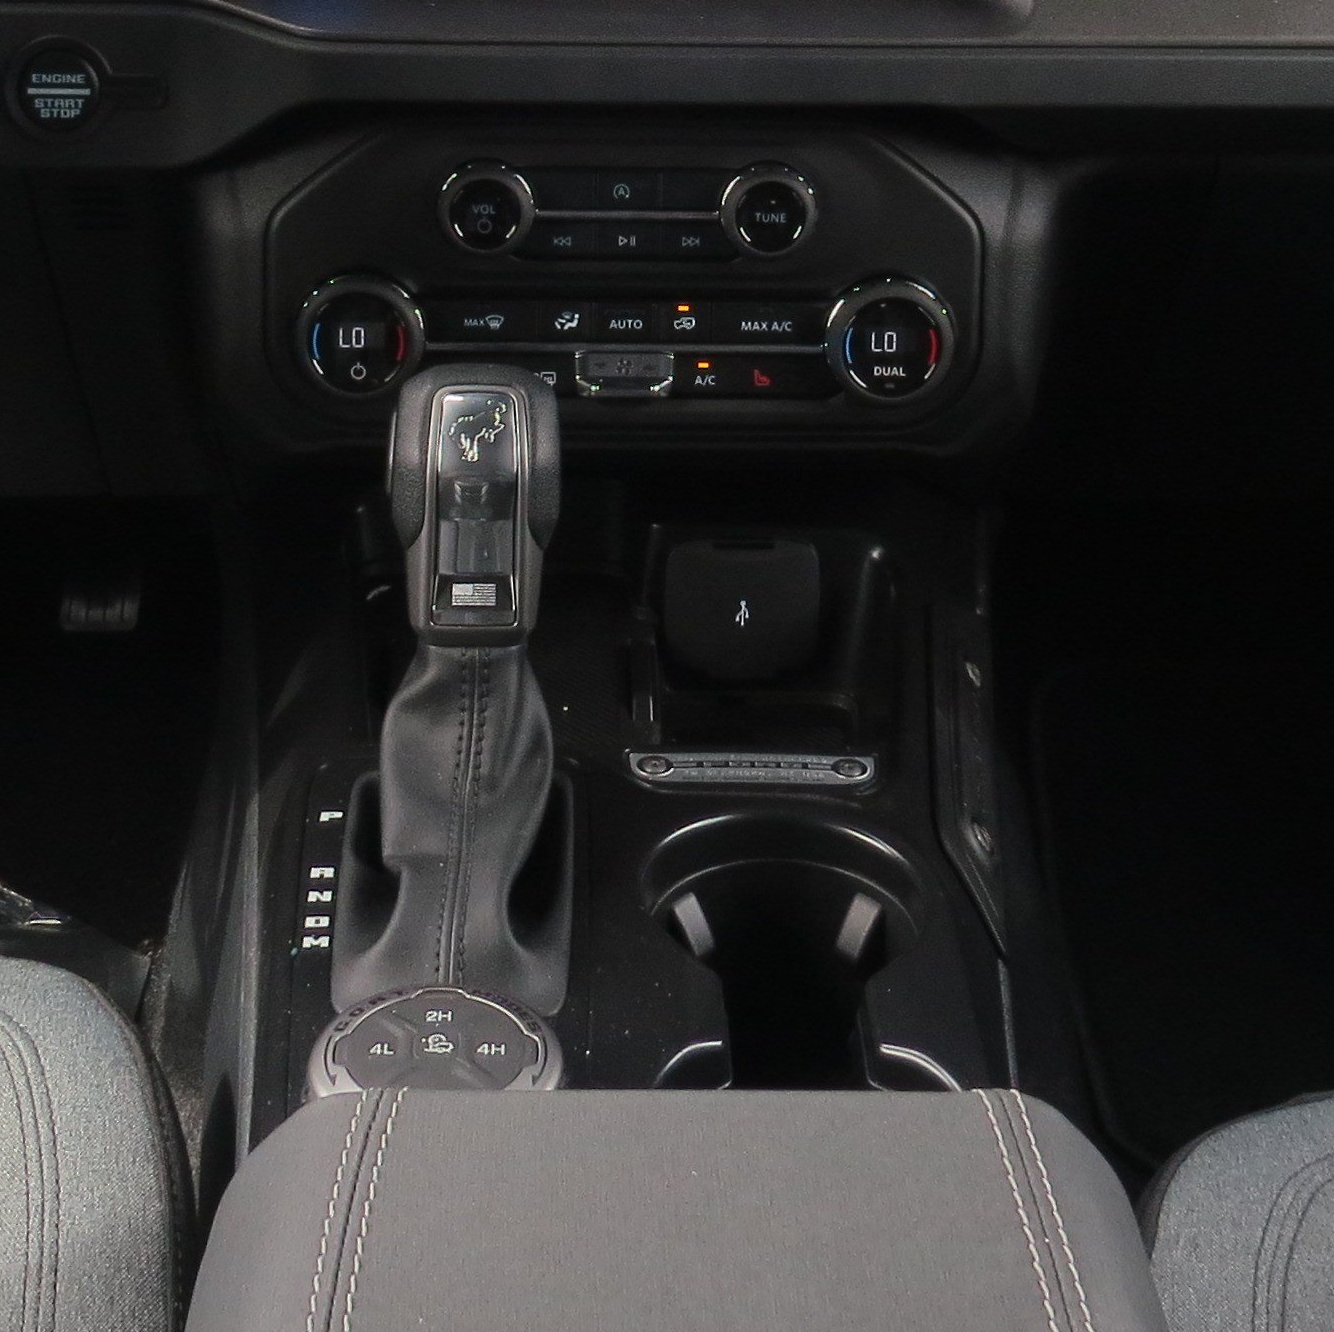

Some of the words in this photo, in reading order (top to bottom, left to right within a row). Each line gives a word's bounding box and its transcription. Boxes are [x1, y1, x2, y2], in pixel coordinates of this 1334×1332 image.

[31, 73, 86, 84] ENGINE
[34, 98, 85, 108] START
[40, 108, 81, 118] STOP
[472, 204, 496, 215] VOL
[755, 212, 787, 223] TUNE
[464, 318, 485, 327] MAX
[609, 319, 643, 330] AUTO
[741, 320, 768, 332] MAX
[771, 320, 793, 332] A/C
[338, 327, 365, 348] LO
[870, 332, 896, 353] LO
[874, 366, 906, 377] DUAL
[695, 375, 716, 387] A/C
[320, 811, 344, 822] P
[307, 890, 332, 902] N
[304, 916, 330, 927] D
[302, 936, 330, 948] M
[425, 1010, 452, 1022] 2H
[369, 1044, 395, 1055] 4L
[476, 1044, 506, 1055] 4H
